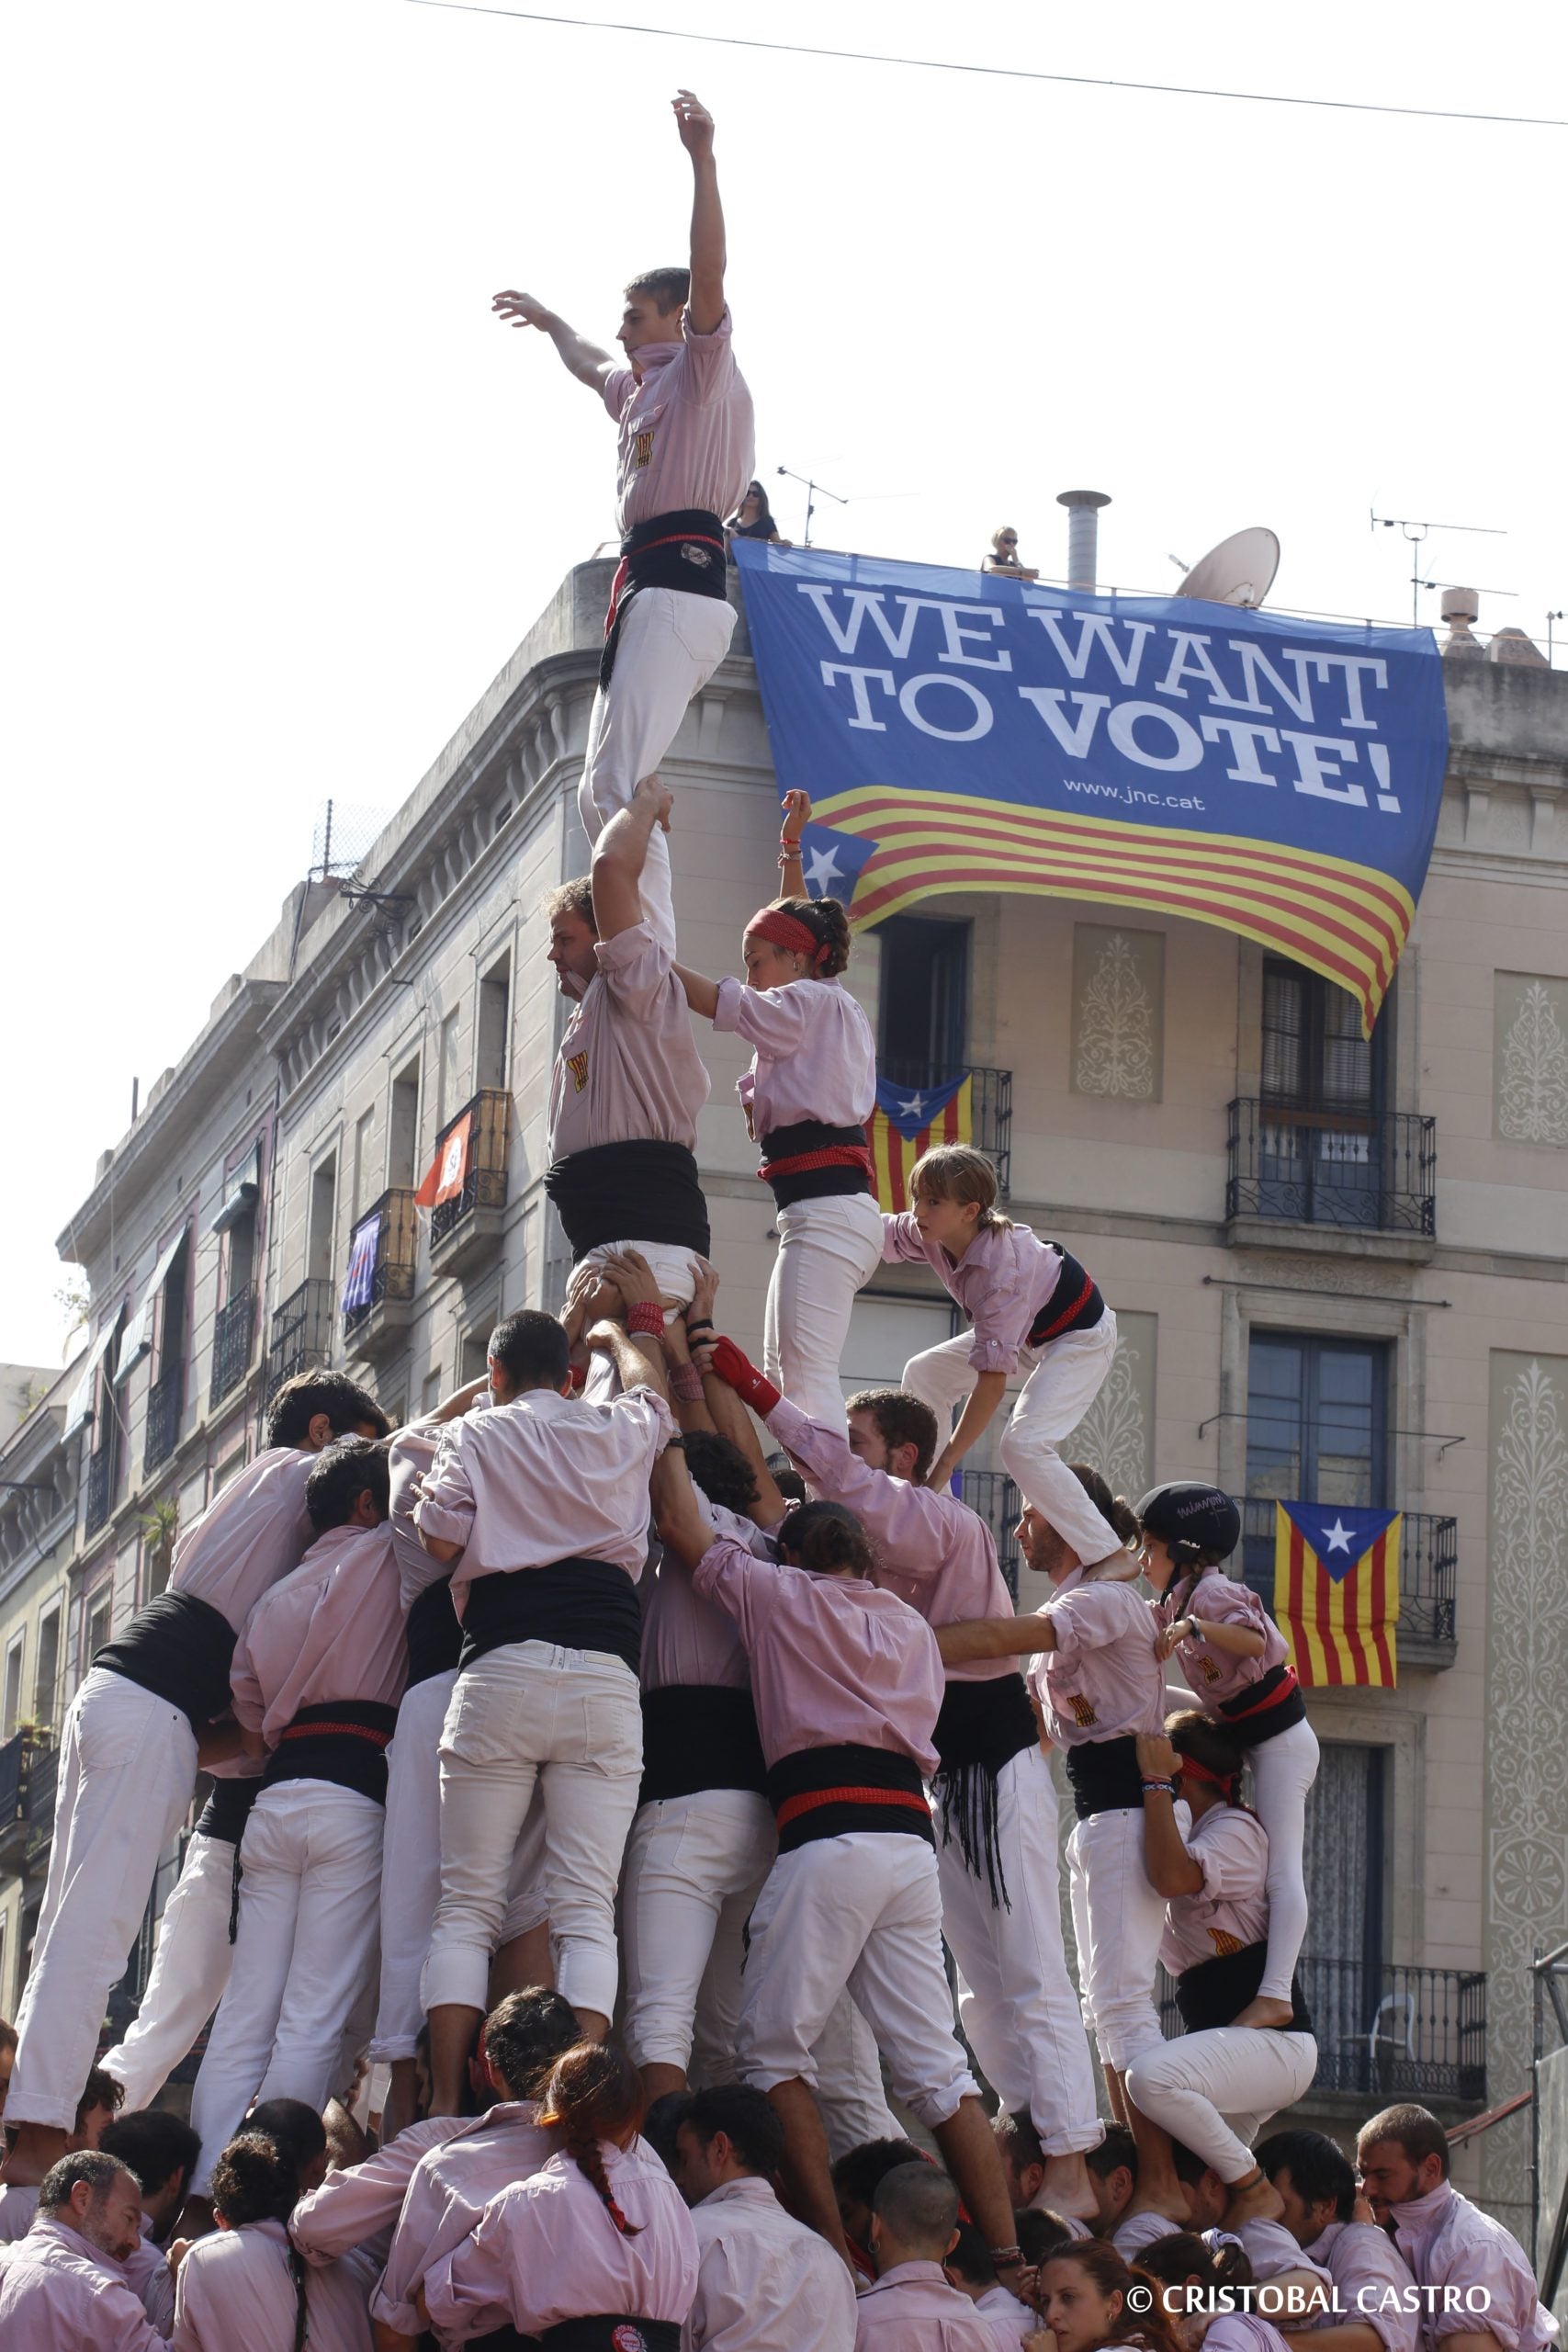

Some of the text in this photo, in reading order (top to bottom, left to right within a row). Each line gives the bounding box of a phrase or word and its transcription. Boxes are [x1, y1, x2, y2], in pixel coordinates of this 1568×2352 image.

[796, 583, 1389, 730] WE WANT
[820, 661, 1402, 814] TO VOTE!
[1063, 779, 1206, 811] www.jnc.cat
